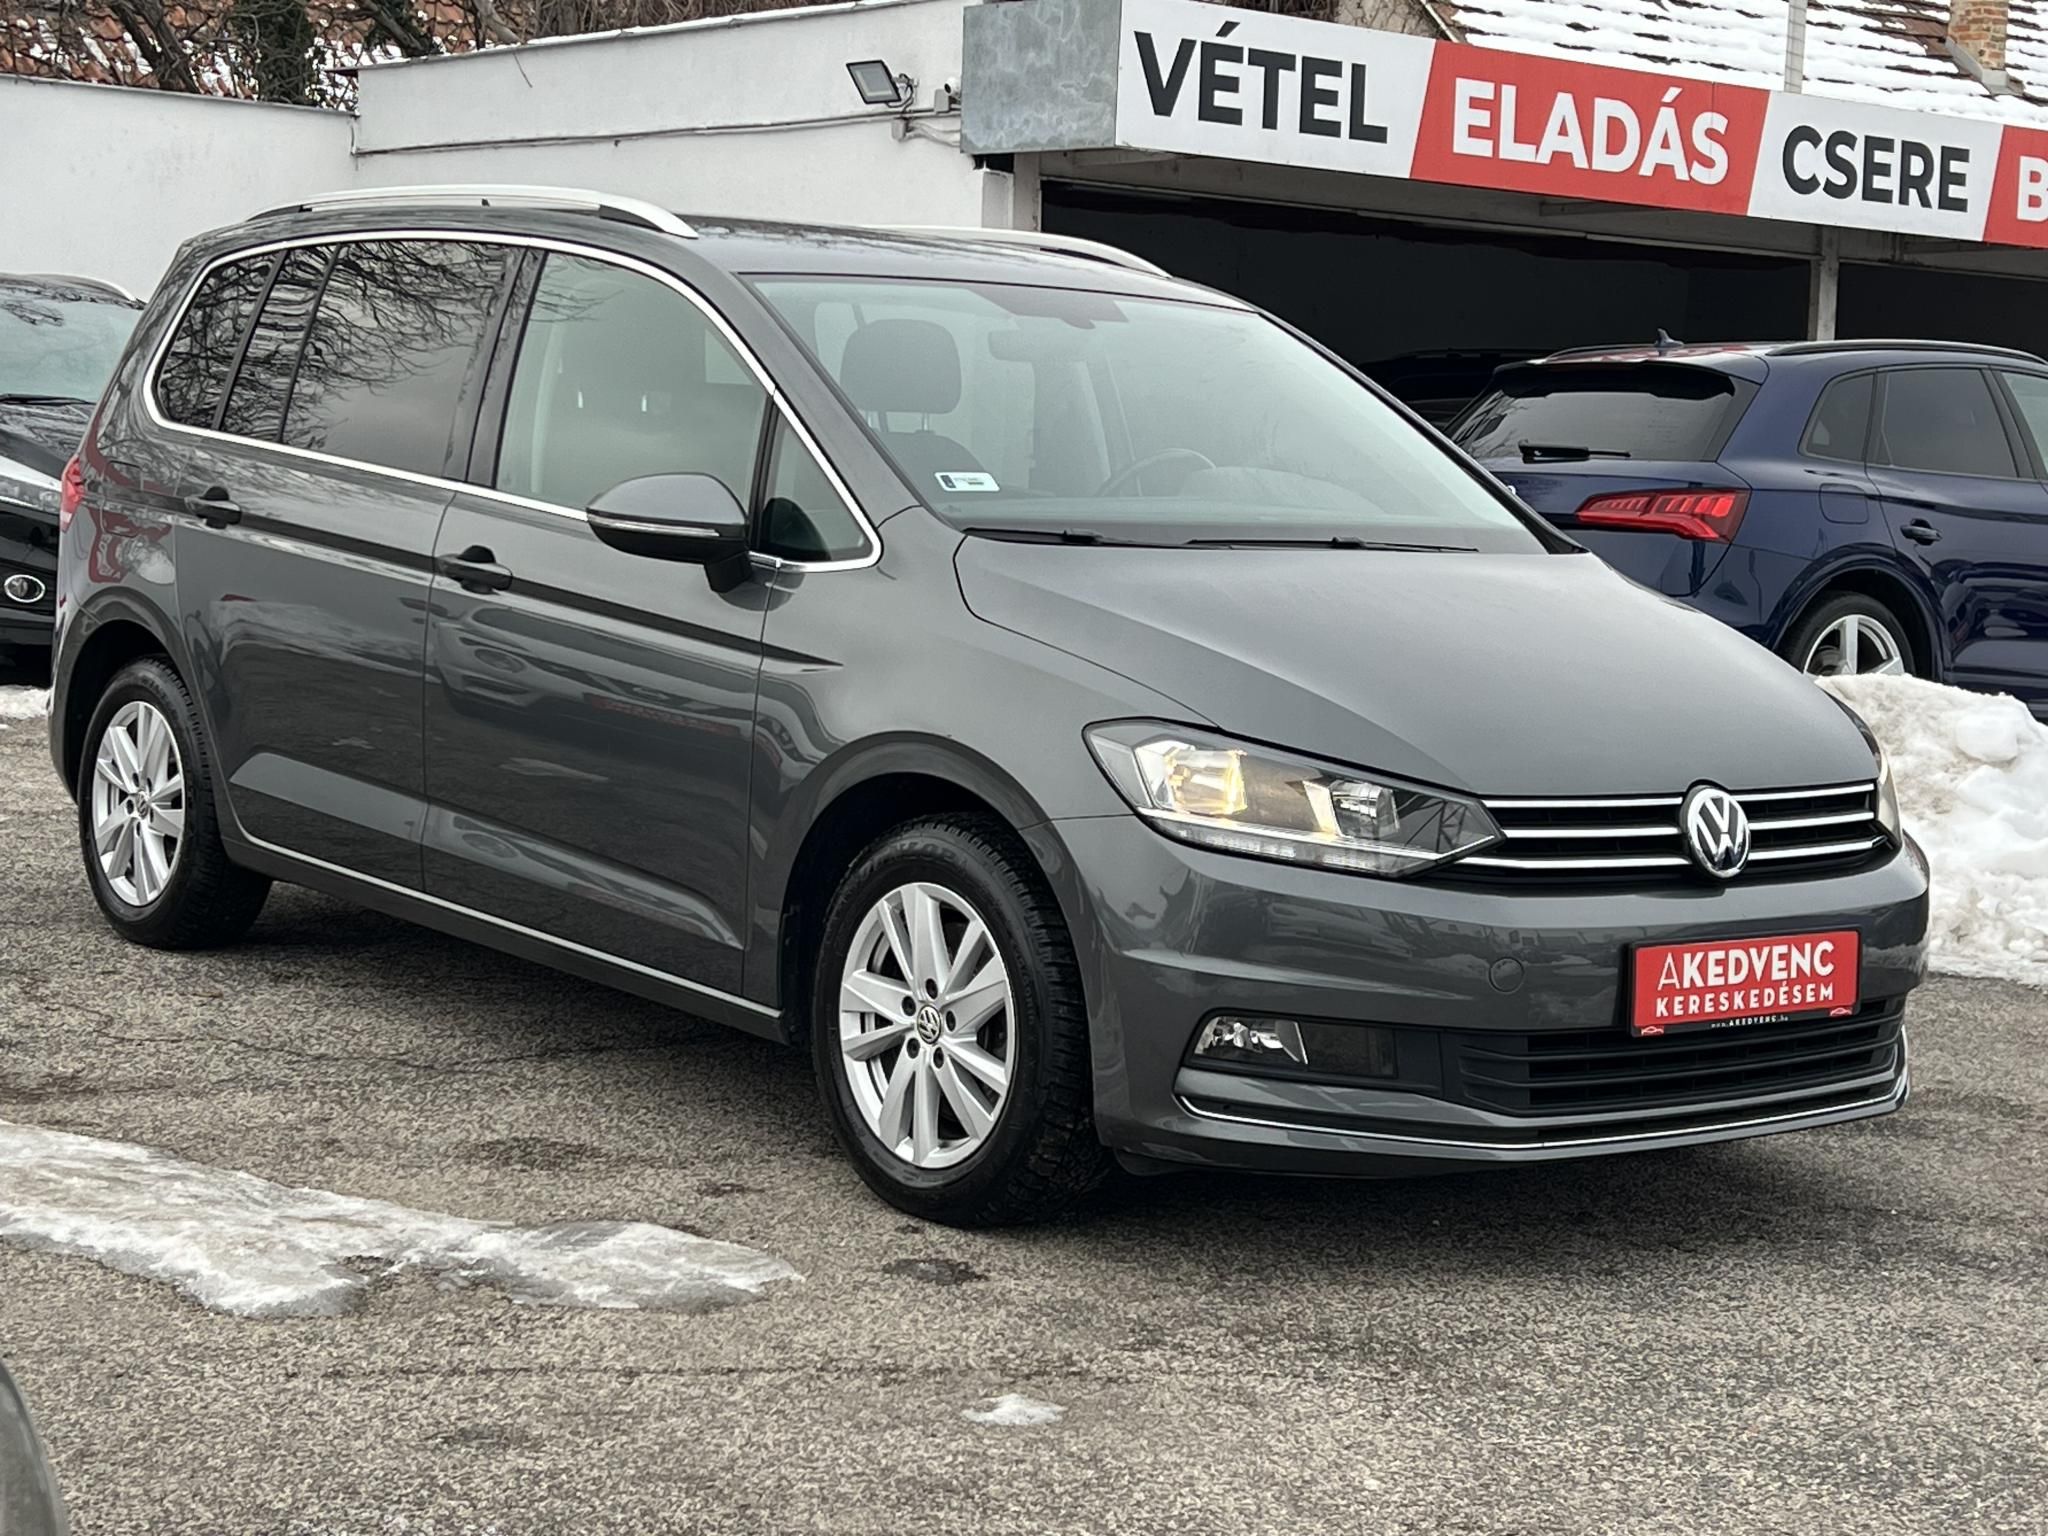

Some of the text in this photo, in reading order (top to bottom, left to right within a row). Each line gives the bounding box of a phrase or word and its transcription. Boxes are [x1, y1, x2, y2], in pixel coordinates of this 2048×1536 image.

[1134, 21, 1388, 144] VÉTEL
[1453, 77, 1730, 185] ELADÁS
[1782, 125, 1970, 213] CSERE
[1656, 980, 1834, 1018] KERESKEDÉSEM
